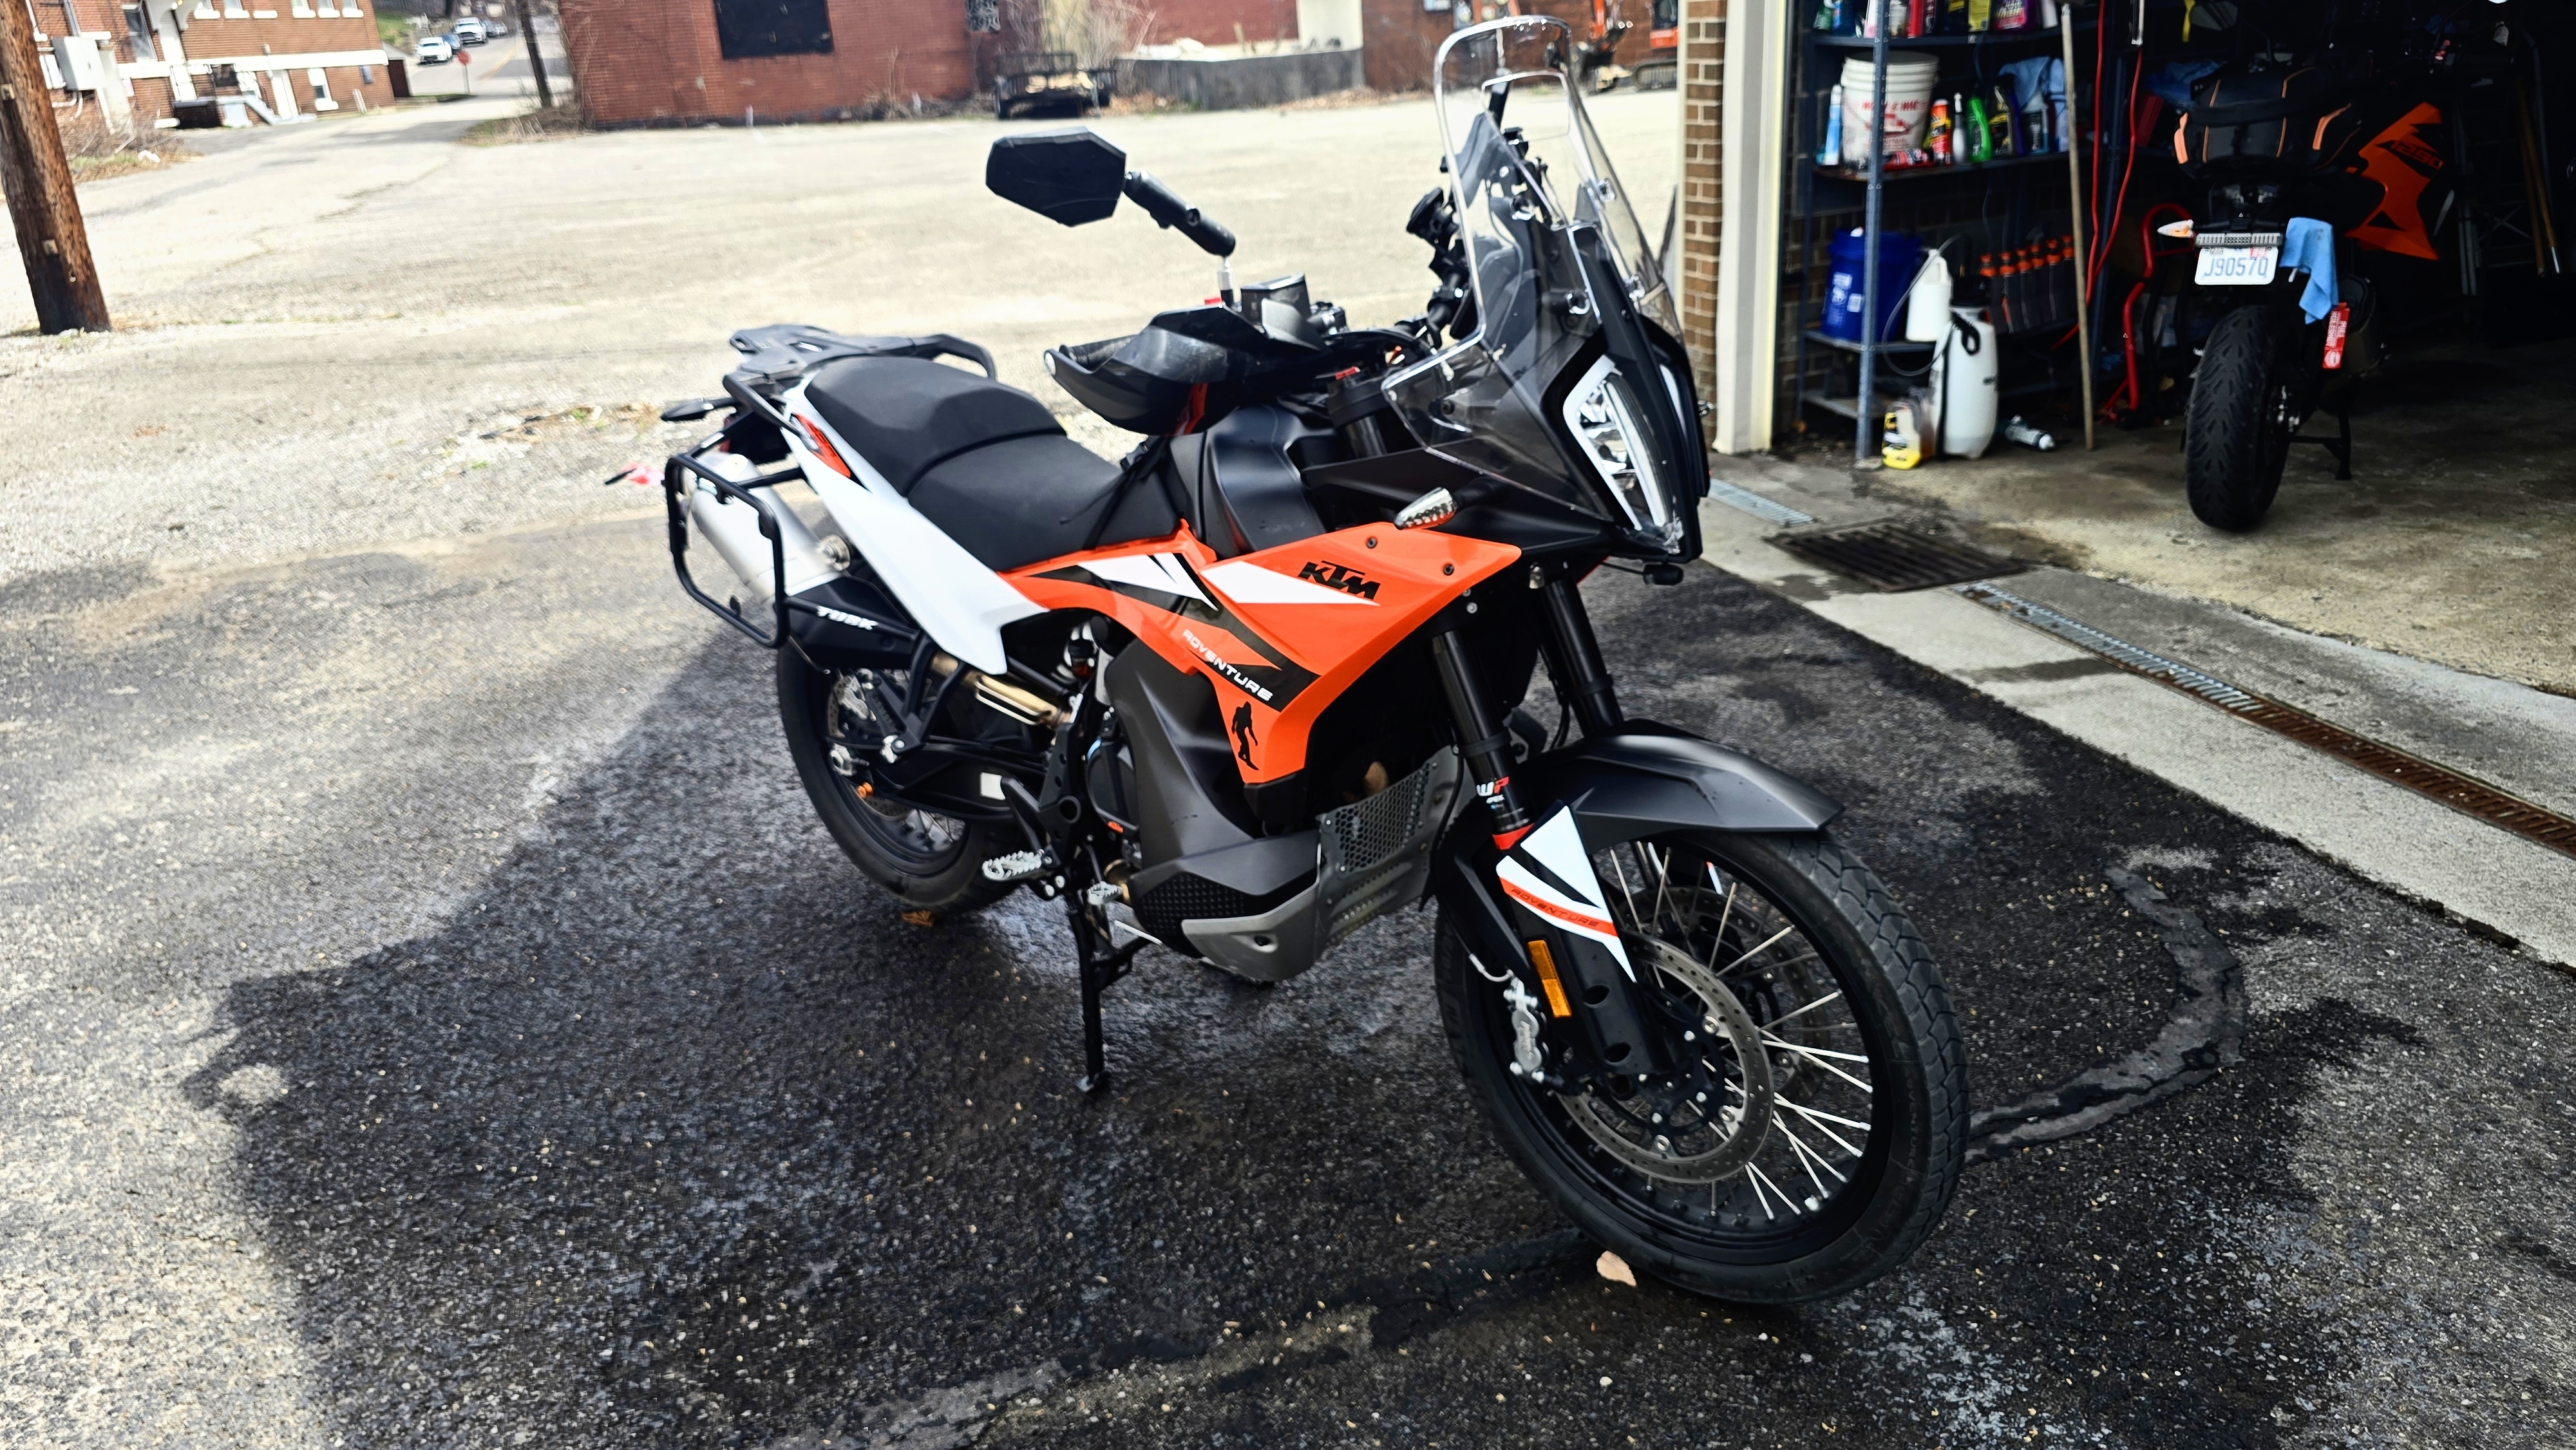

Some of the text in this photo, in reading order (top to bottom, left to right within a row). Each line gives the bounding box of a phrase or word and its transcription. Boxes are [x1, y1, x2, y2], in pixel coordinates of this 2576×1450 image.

[2391, 141, 2444, 169] 1290
[1298, 560, 1381, 600] KTM
[816, 605, 879, 630] TUSK
[1182, 628, 1273, 701] ADVENTURE
[1476, 776, 1509, 796] WP
[1511, 888, 1600, 927] ADVENTURE
